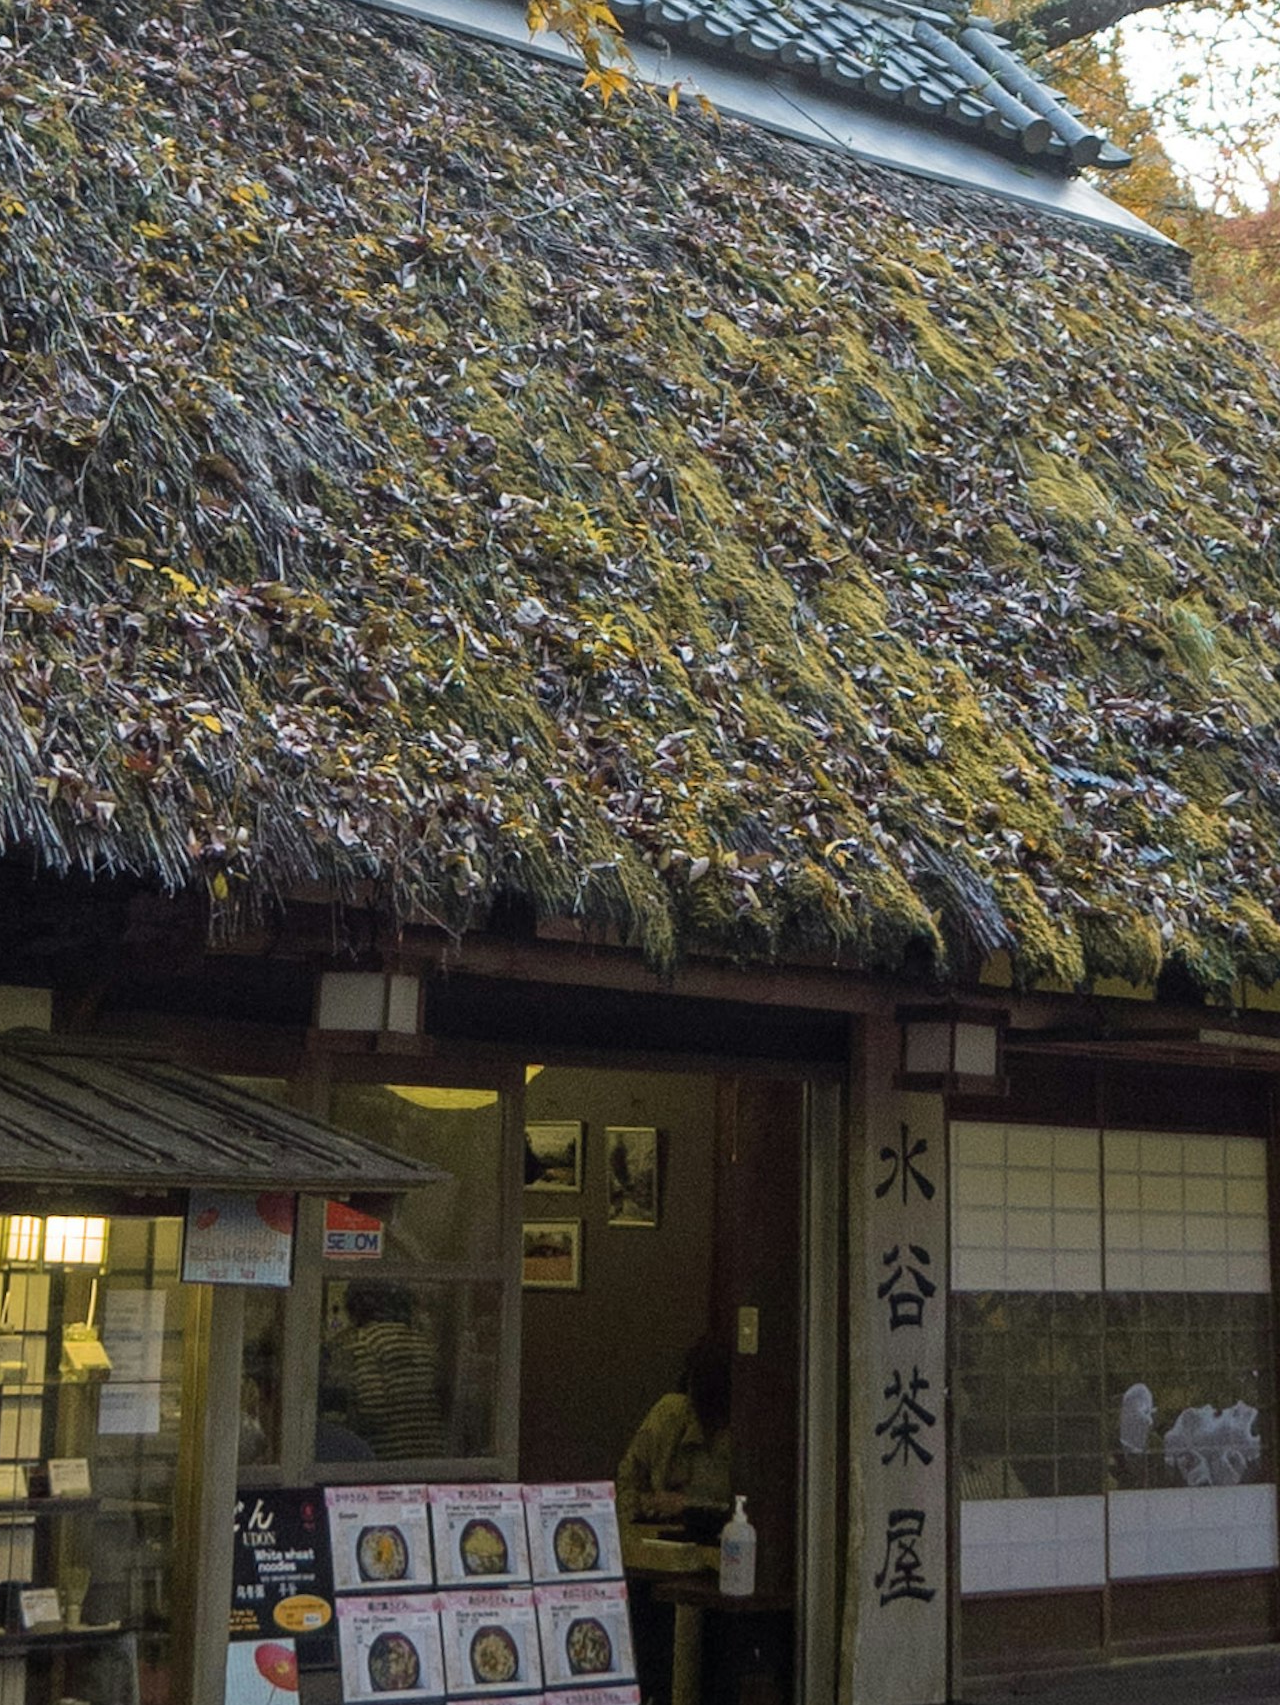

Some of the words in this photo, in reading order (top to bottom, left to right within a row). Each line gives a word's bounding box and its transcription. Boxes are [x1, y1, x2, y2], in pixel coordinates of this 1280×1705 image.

[328, 1233, 377, 1251] SEOM
[874, 1123, 936, 1607] 水谷茶屋
[243, 1531, 277, 1545] UDON
[254, 1548, 283, 1561] White
[285, 1547, 316, 1559] wheat
[258, 1560, 297, 1573] noodles
